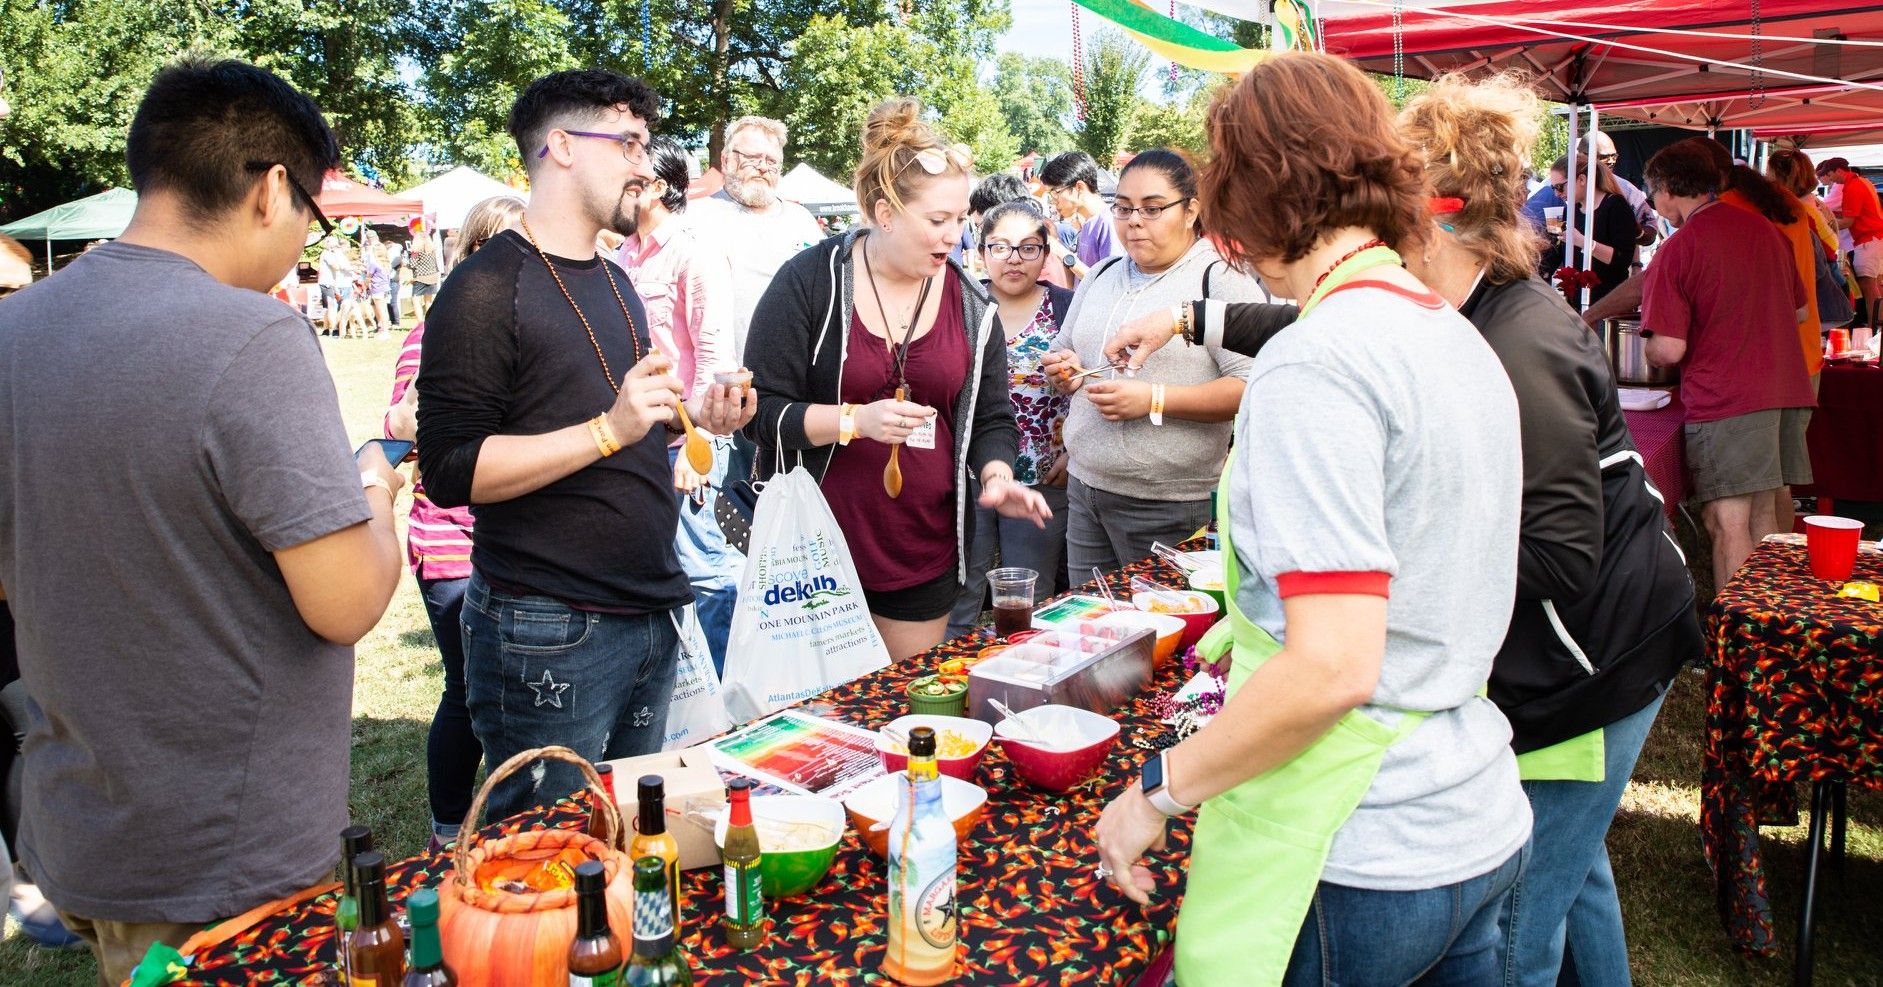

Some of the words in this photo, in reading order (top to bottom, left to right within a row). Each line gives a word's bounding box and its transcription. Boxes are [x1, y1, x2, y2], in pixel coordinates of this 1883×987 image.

[832, 602, 859, 615] PARK
[834, 626, 865, 641] markets
[825, 635, 868, 656] attractions
